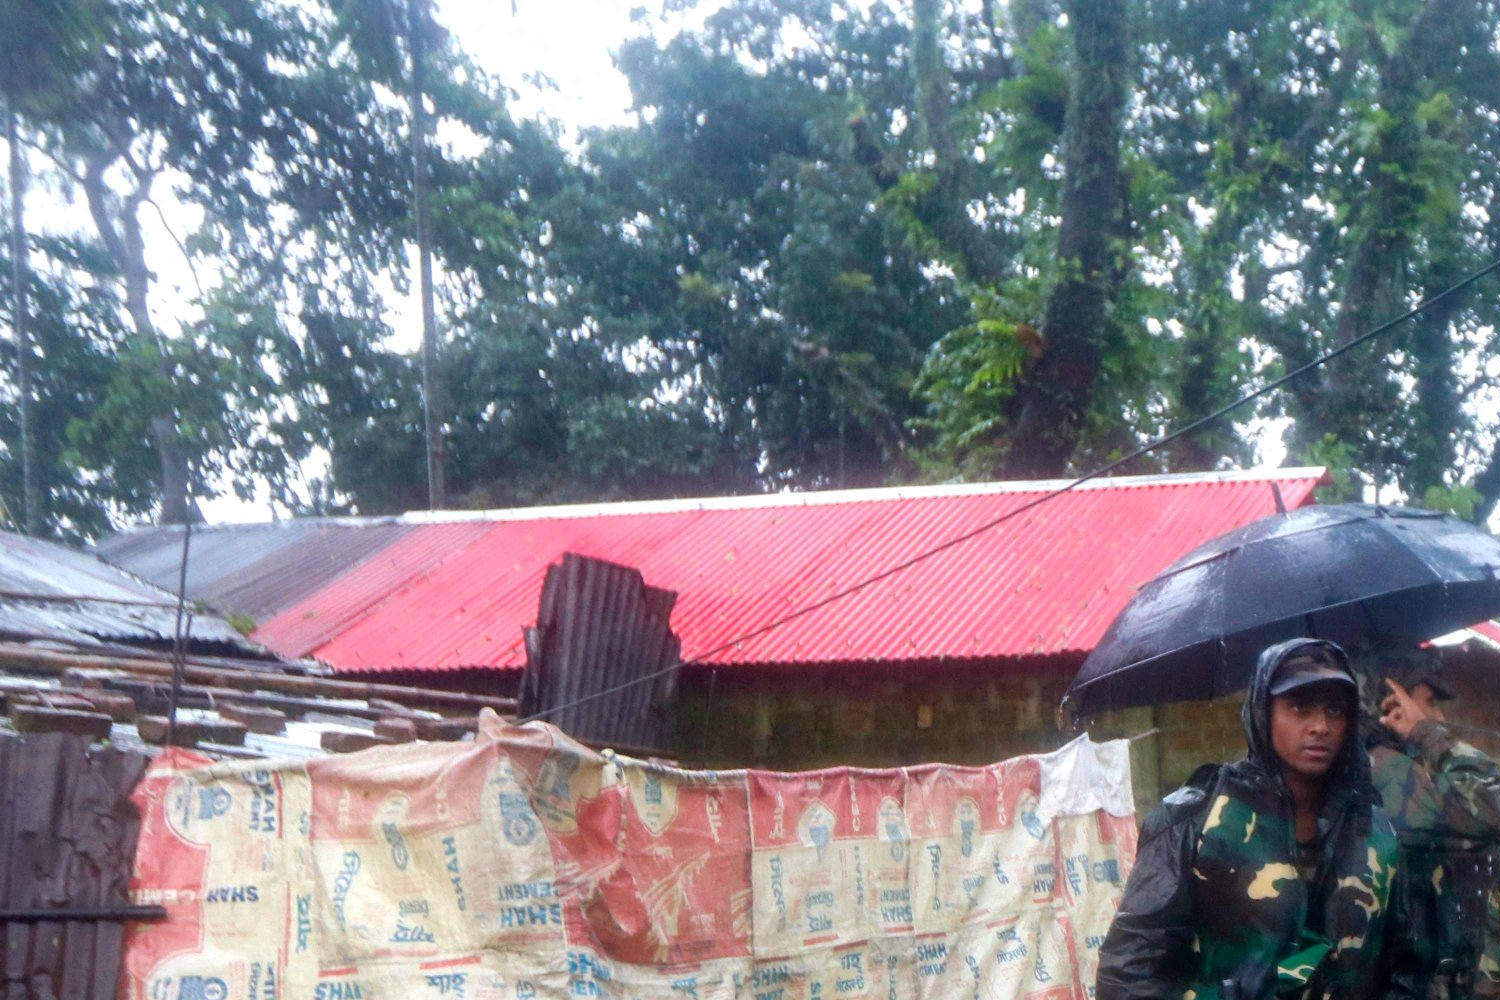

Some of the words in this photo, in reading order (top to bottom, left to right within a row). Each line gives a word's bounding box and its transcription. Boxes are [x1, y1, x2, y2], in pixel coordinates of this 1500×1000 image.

[206, 885, 260, 902] SHAH
[500, 903, 562, 927] SHAH
[880, 905, 913, 923] SHAH
[917, 943, 947, 961] SHAH
[425, 973, 468, 998] শাহ
